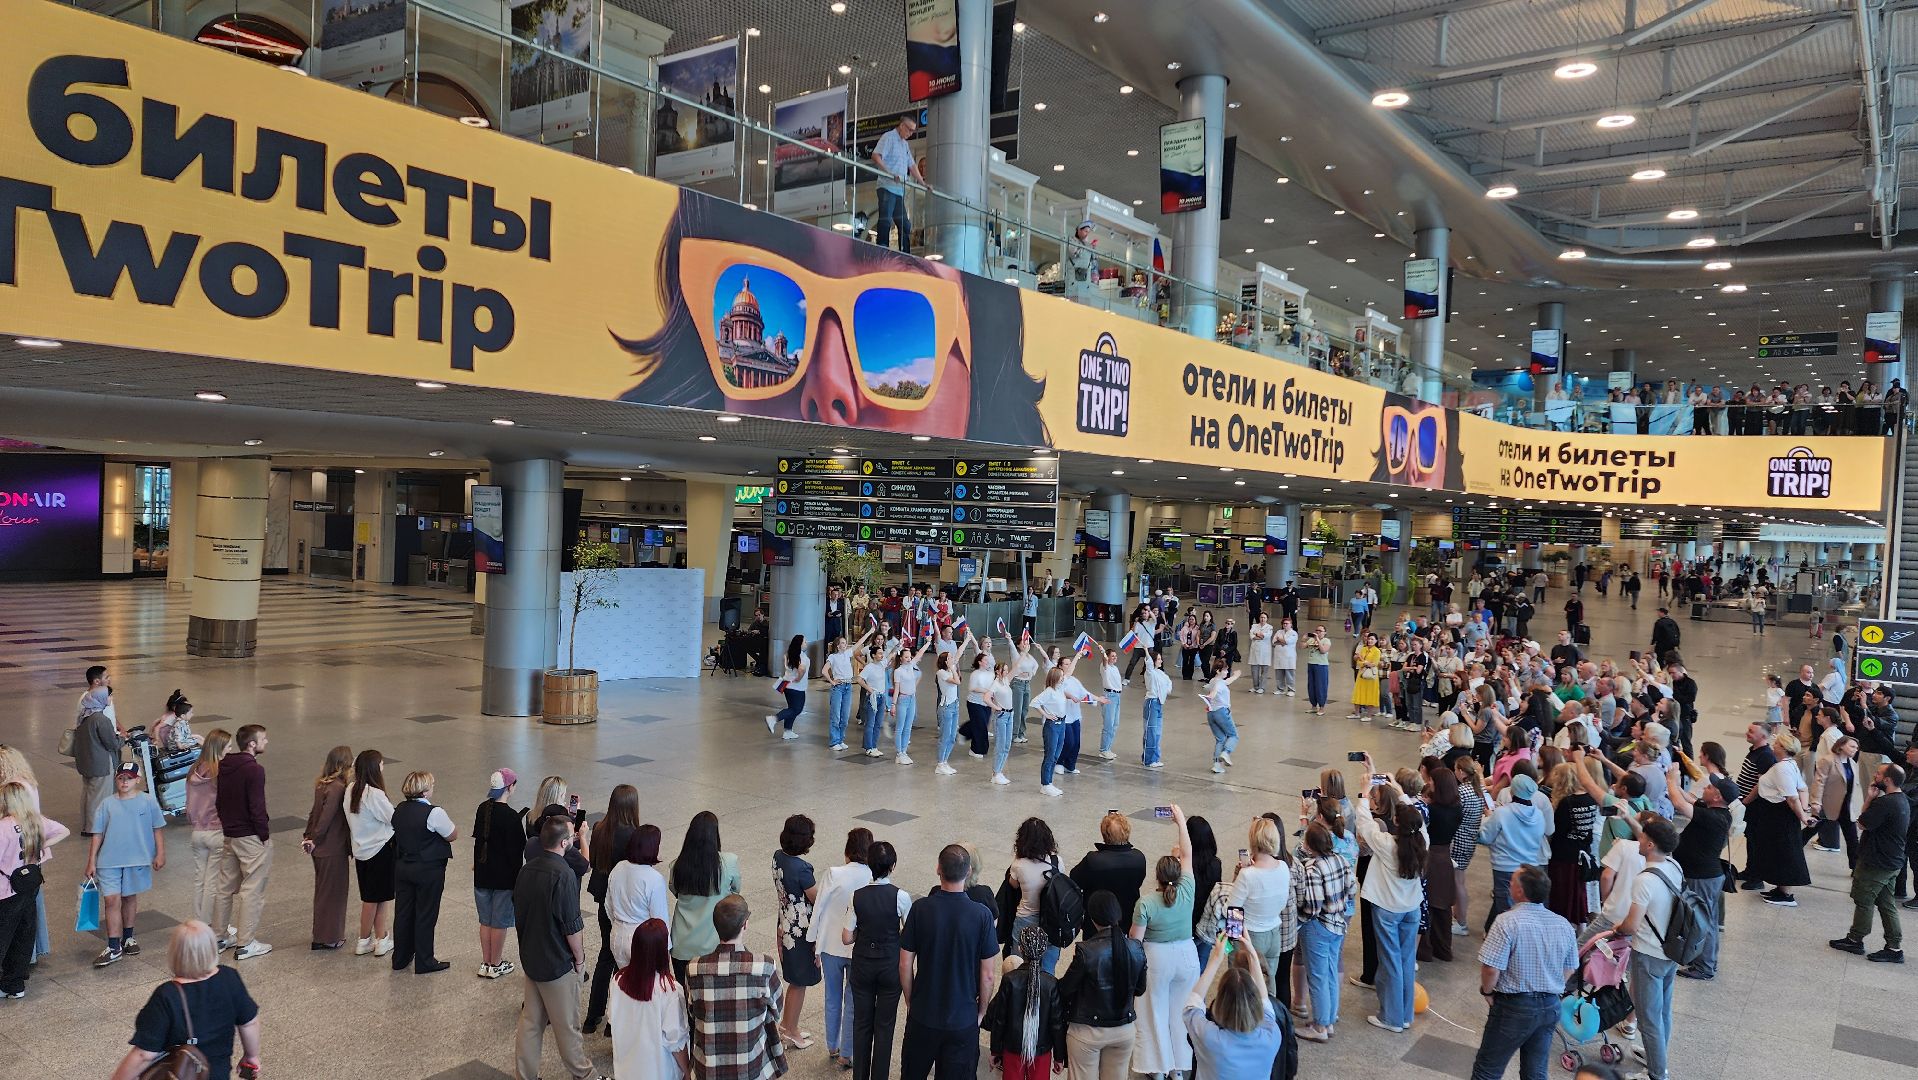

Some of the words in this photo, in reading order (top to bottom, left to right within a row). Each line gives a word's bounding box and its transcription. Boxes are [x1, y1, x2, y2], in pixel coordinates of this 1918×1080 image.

[27, 54, 552, 263] билеты
[1080, 354, 1103, 382] ONE
[1105, 359, 1129, 387] TWO
[1079, 383, 1128, 431] TRIP!
[1182, 362, 1256, 408] отели
[1262, 381, 1276, 411] и
[1282, 378, 1353, 426] билеты
[1190, 415, 1220, 450] на
[1227, 413, 1345, 473] OneTwoTrip
[1498, 439, 1532, 461] отели
[1537, 446, 1550, 463] и
[1558, 442, 1676, 468] билеты
[1769, 458, 1796, 472] ONE
[1799, 458, 1831, 472] TWO
[1500, 468, 1511, 487] на
[1513, 466, 1661, 499] OneTwoTrip
[1769, 472, 1829, 497] TRIP!
[665, 536, 673, 544] 64
[904, 551, 914, 560] 59
